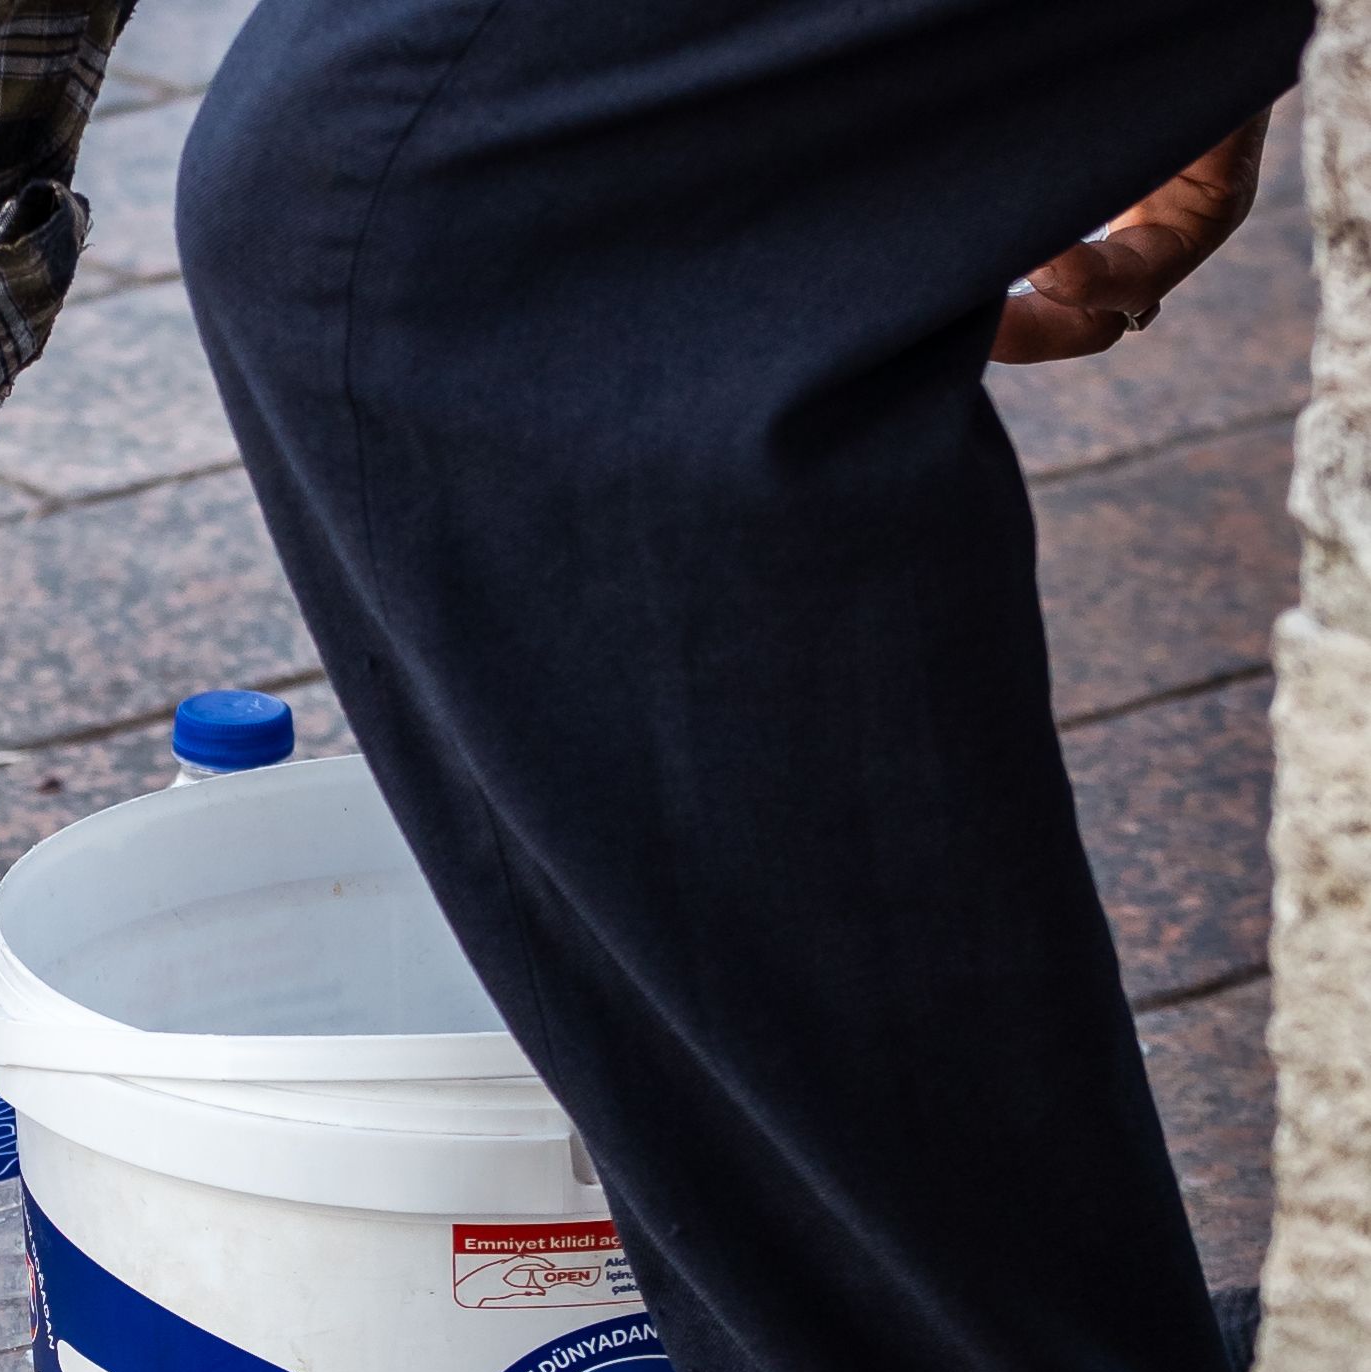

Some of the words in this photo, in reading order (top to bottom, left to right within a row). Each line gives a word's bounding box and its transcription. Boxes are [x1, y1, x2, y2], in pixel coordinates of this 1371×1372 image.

[464, 1235, 546, 1252] Emniyet
[550, 1236, 595, 1248] kilidi
[543, 1271, 591, 1282] OPEN
